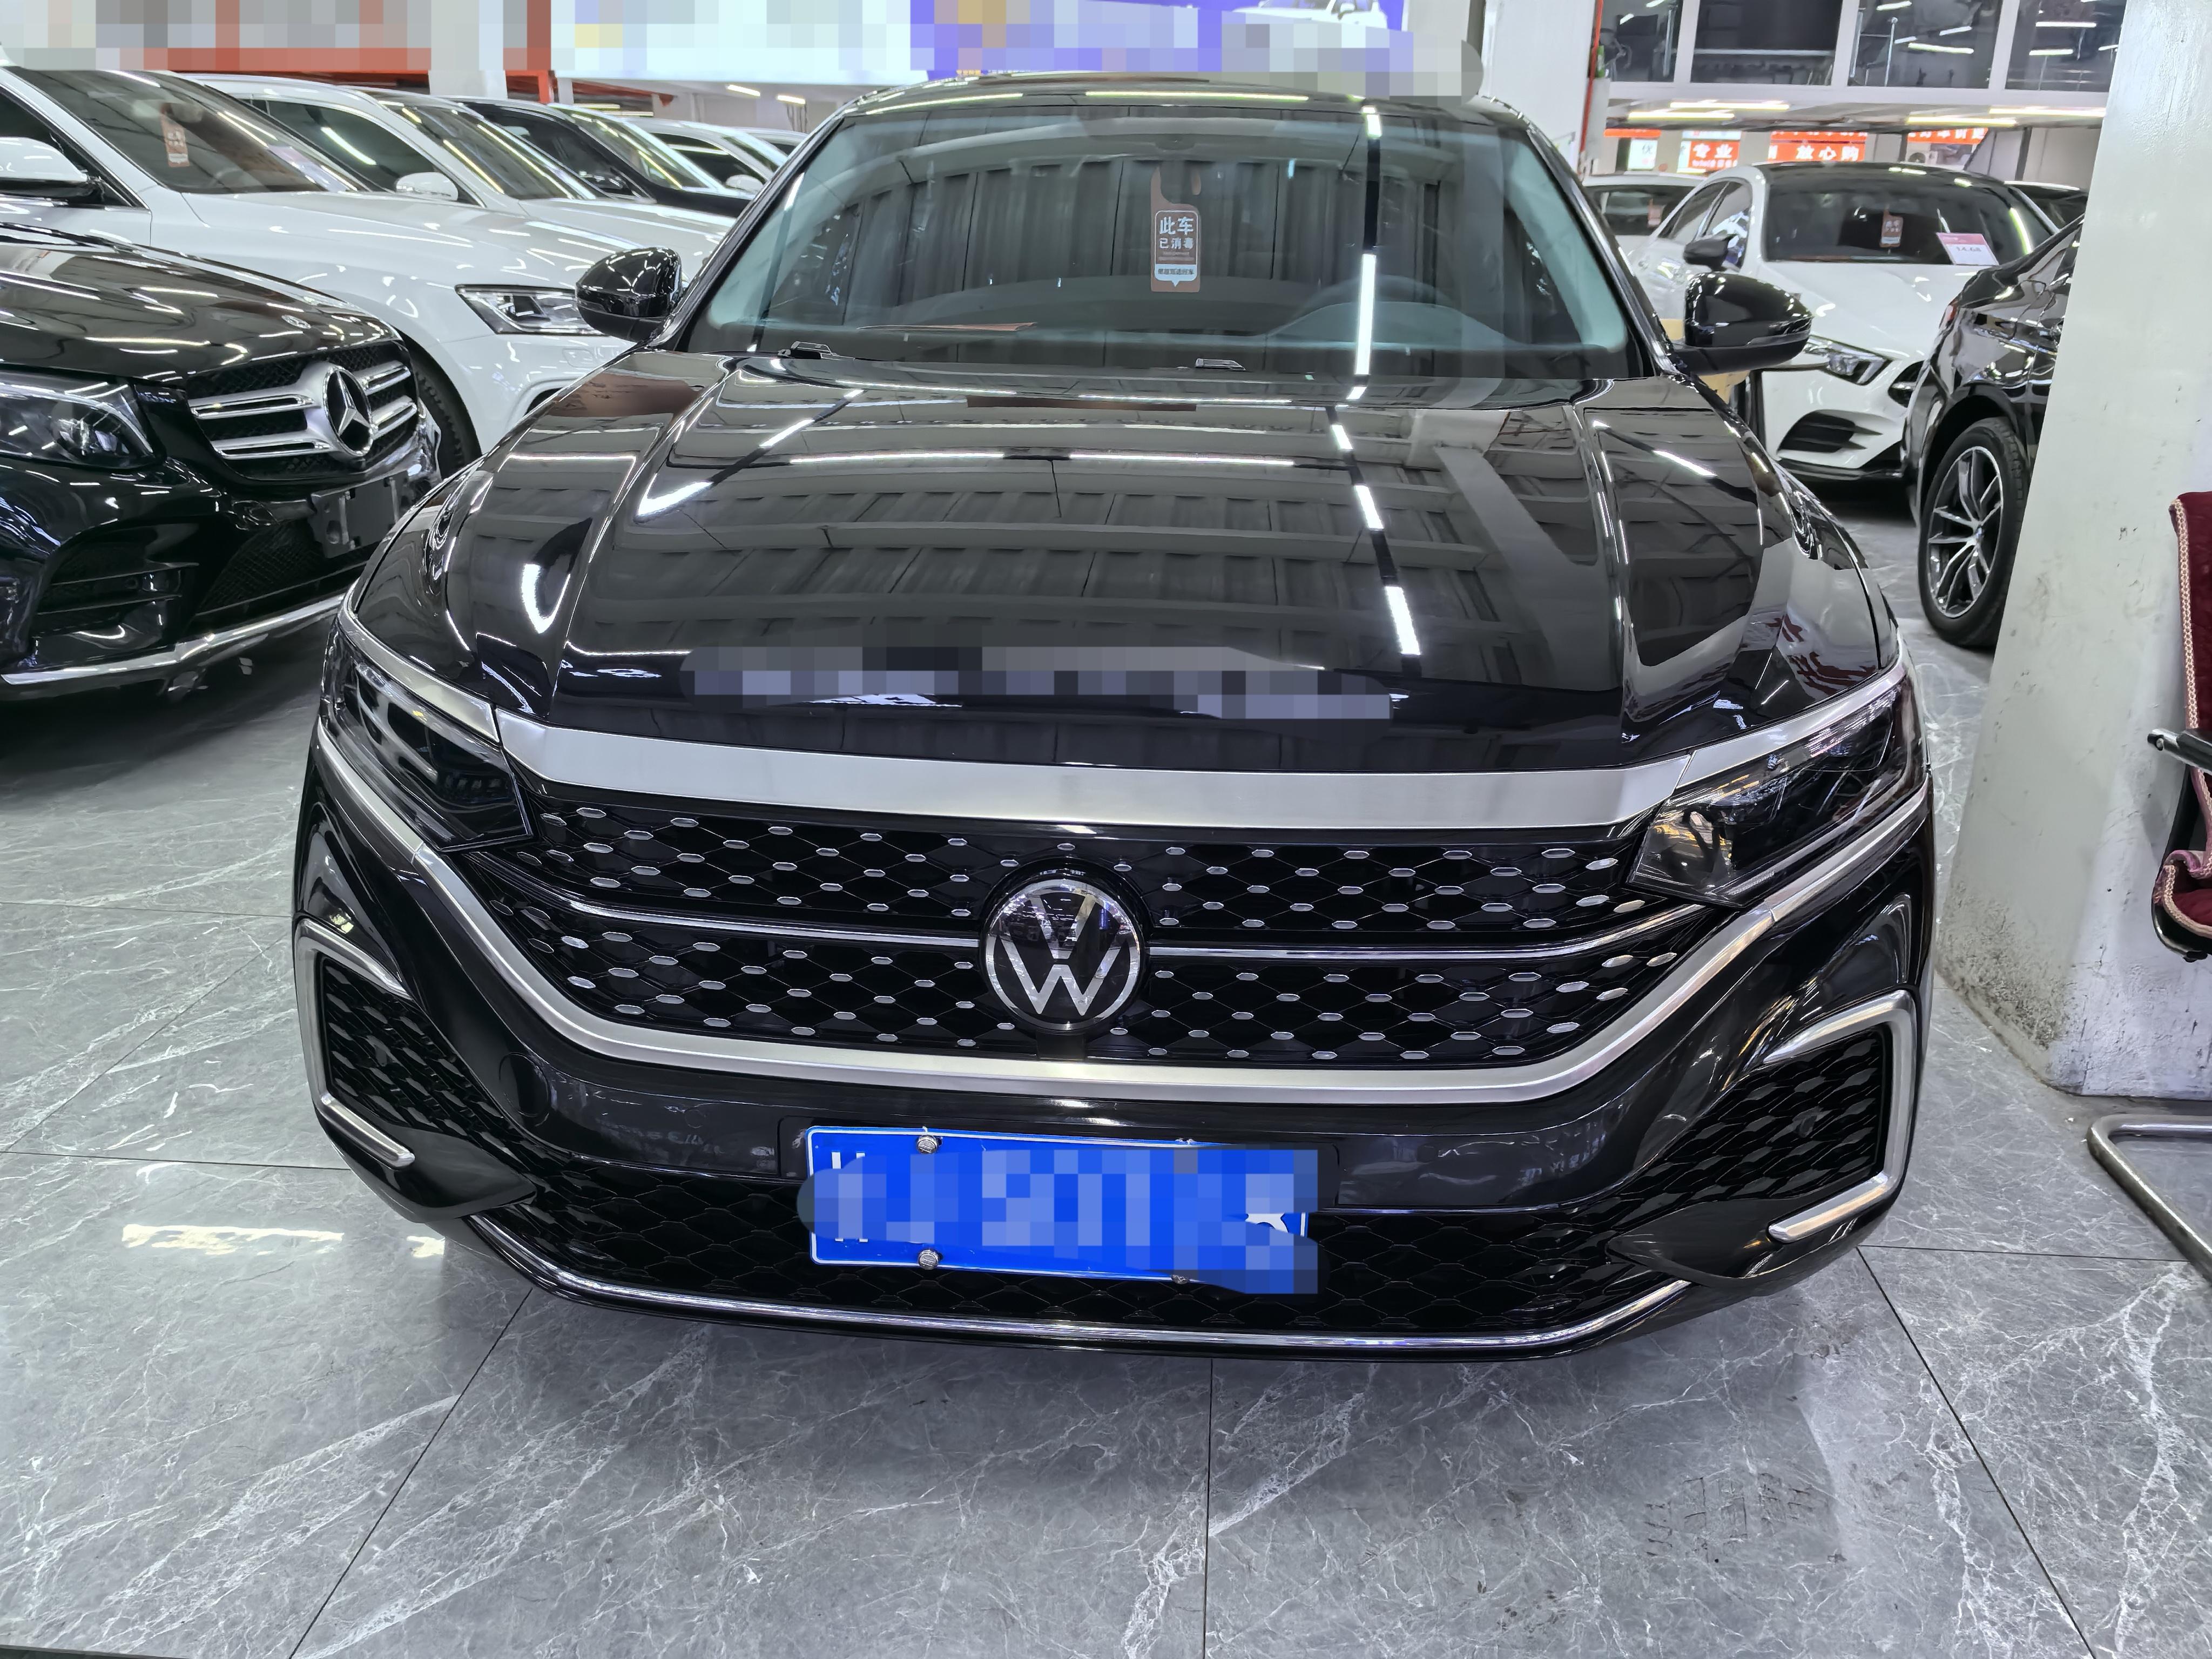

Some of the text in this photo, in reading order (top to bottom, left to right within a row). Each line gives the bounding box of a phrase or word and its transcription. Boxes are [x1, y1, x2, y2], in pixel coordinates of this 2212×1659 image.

[1692, 143, 1733, 159] 专业
[1159, 217, 1193, 235] 此车
[1159, 237, 1193, 249] 已消毒
